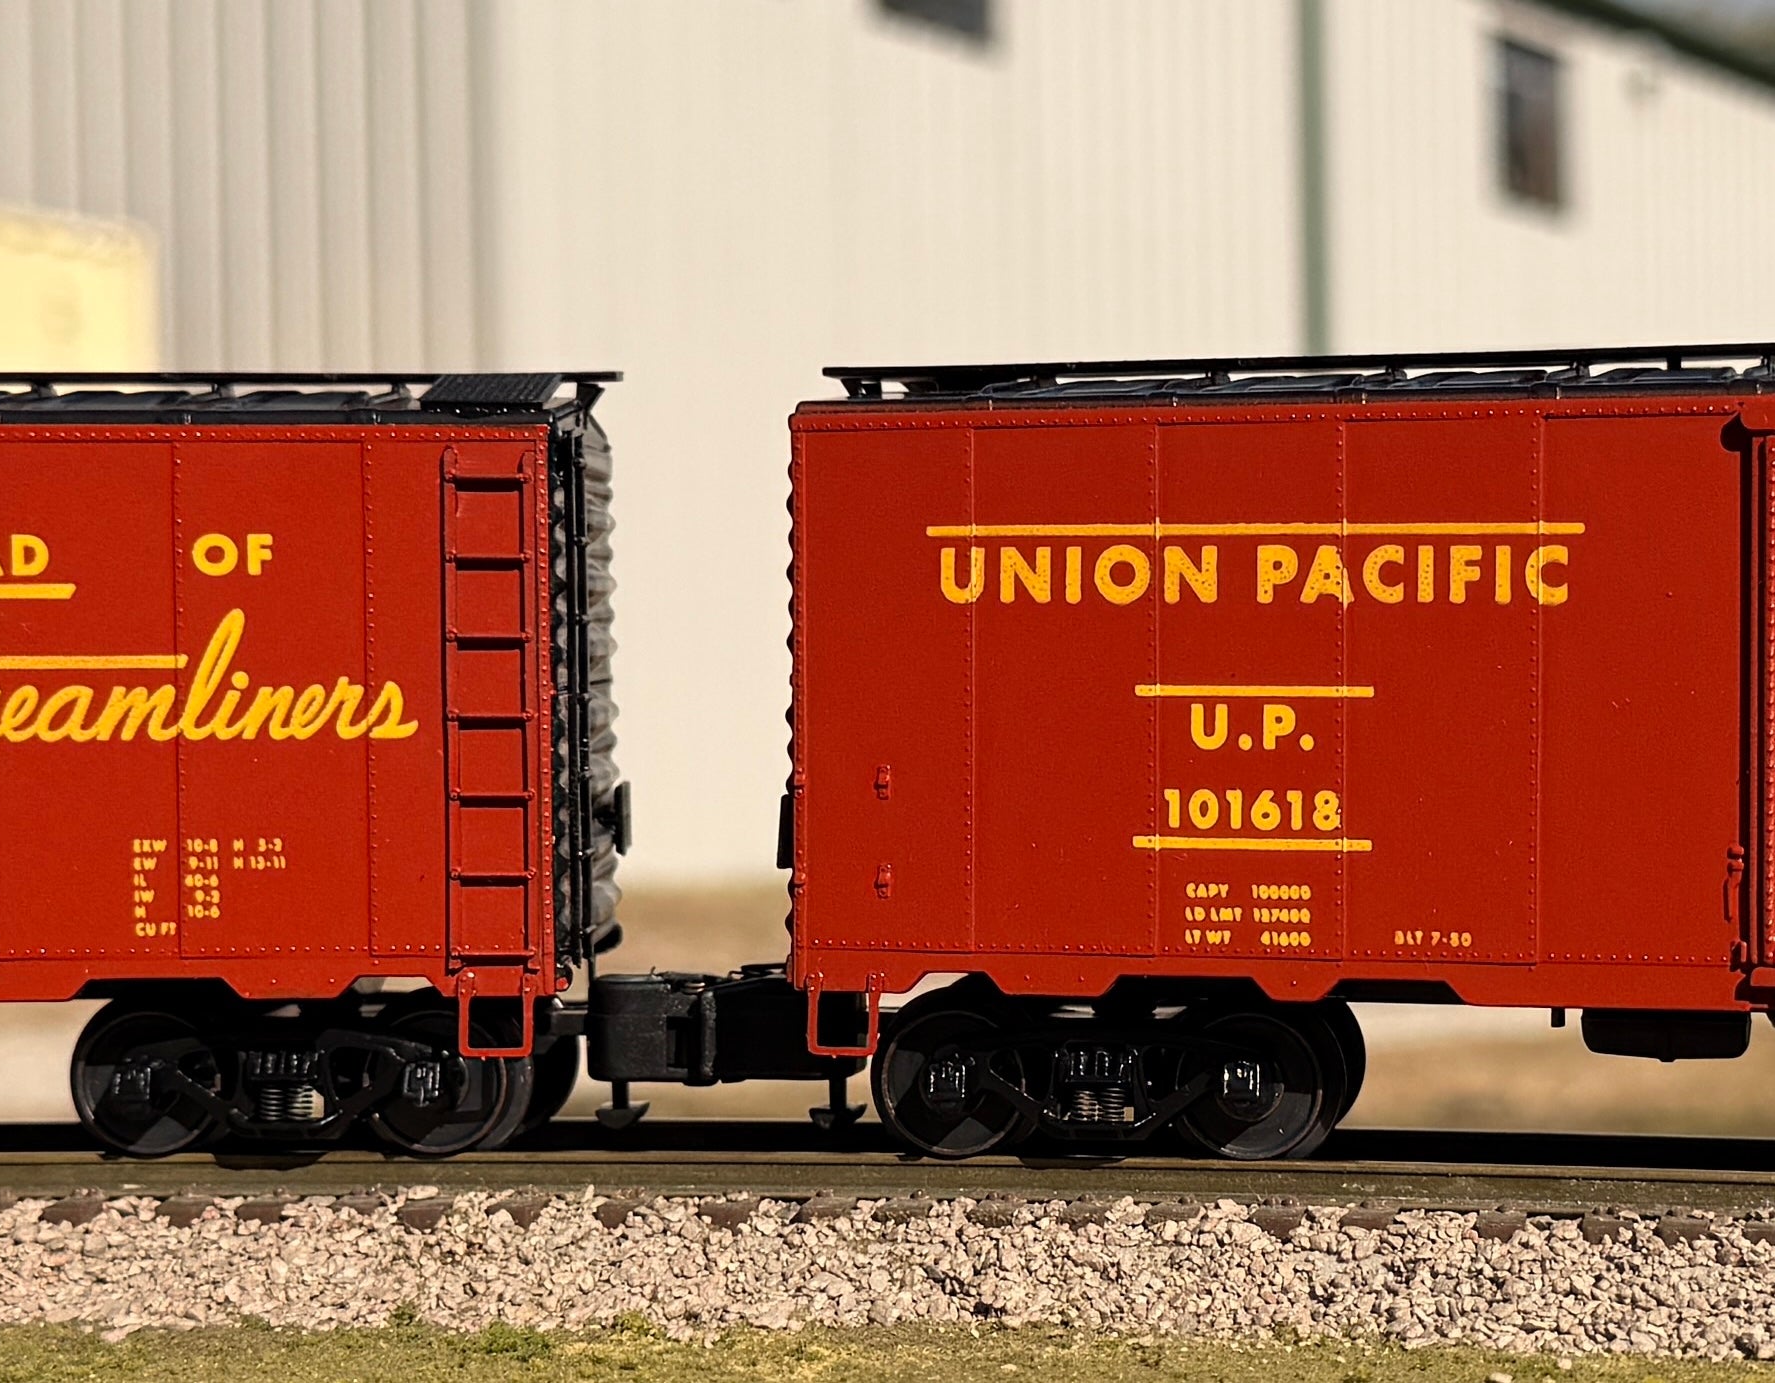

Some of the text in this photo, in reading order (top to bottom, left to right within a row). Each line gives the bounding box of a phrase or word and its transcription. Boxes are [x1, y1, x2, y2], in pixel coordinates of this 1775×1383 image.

[191, 532, 274, 577] OF
[940, 544, 1569, 607] UNION PACIFIC
[1190, 703, 1315, 752] U.P.
[1163, 788, 1343, 832] 101618
